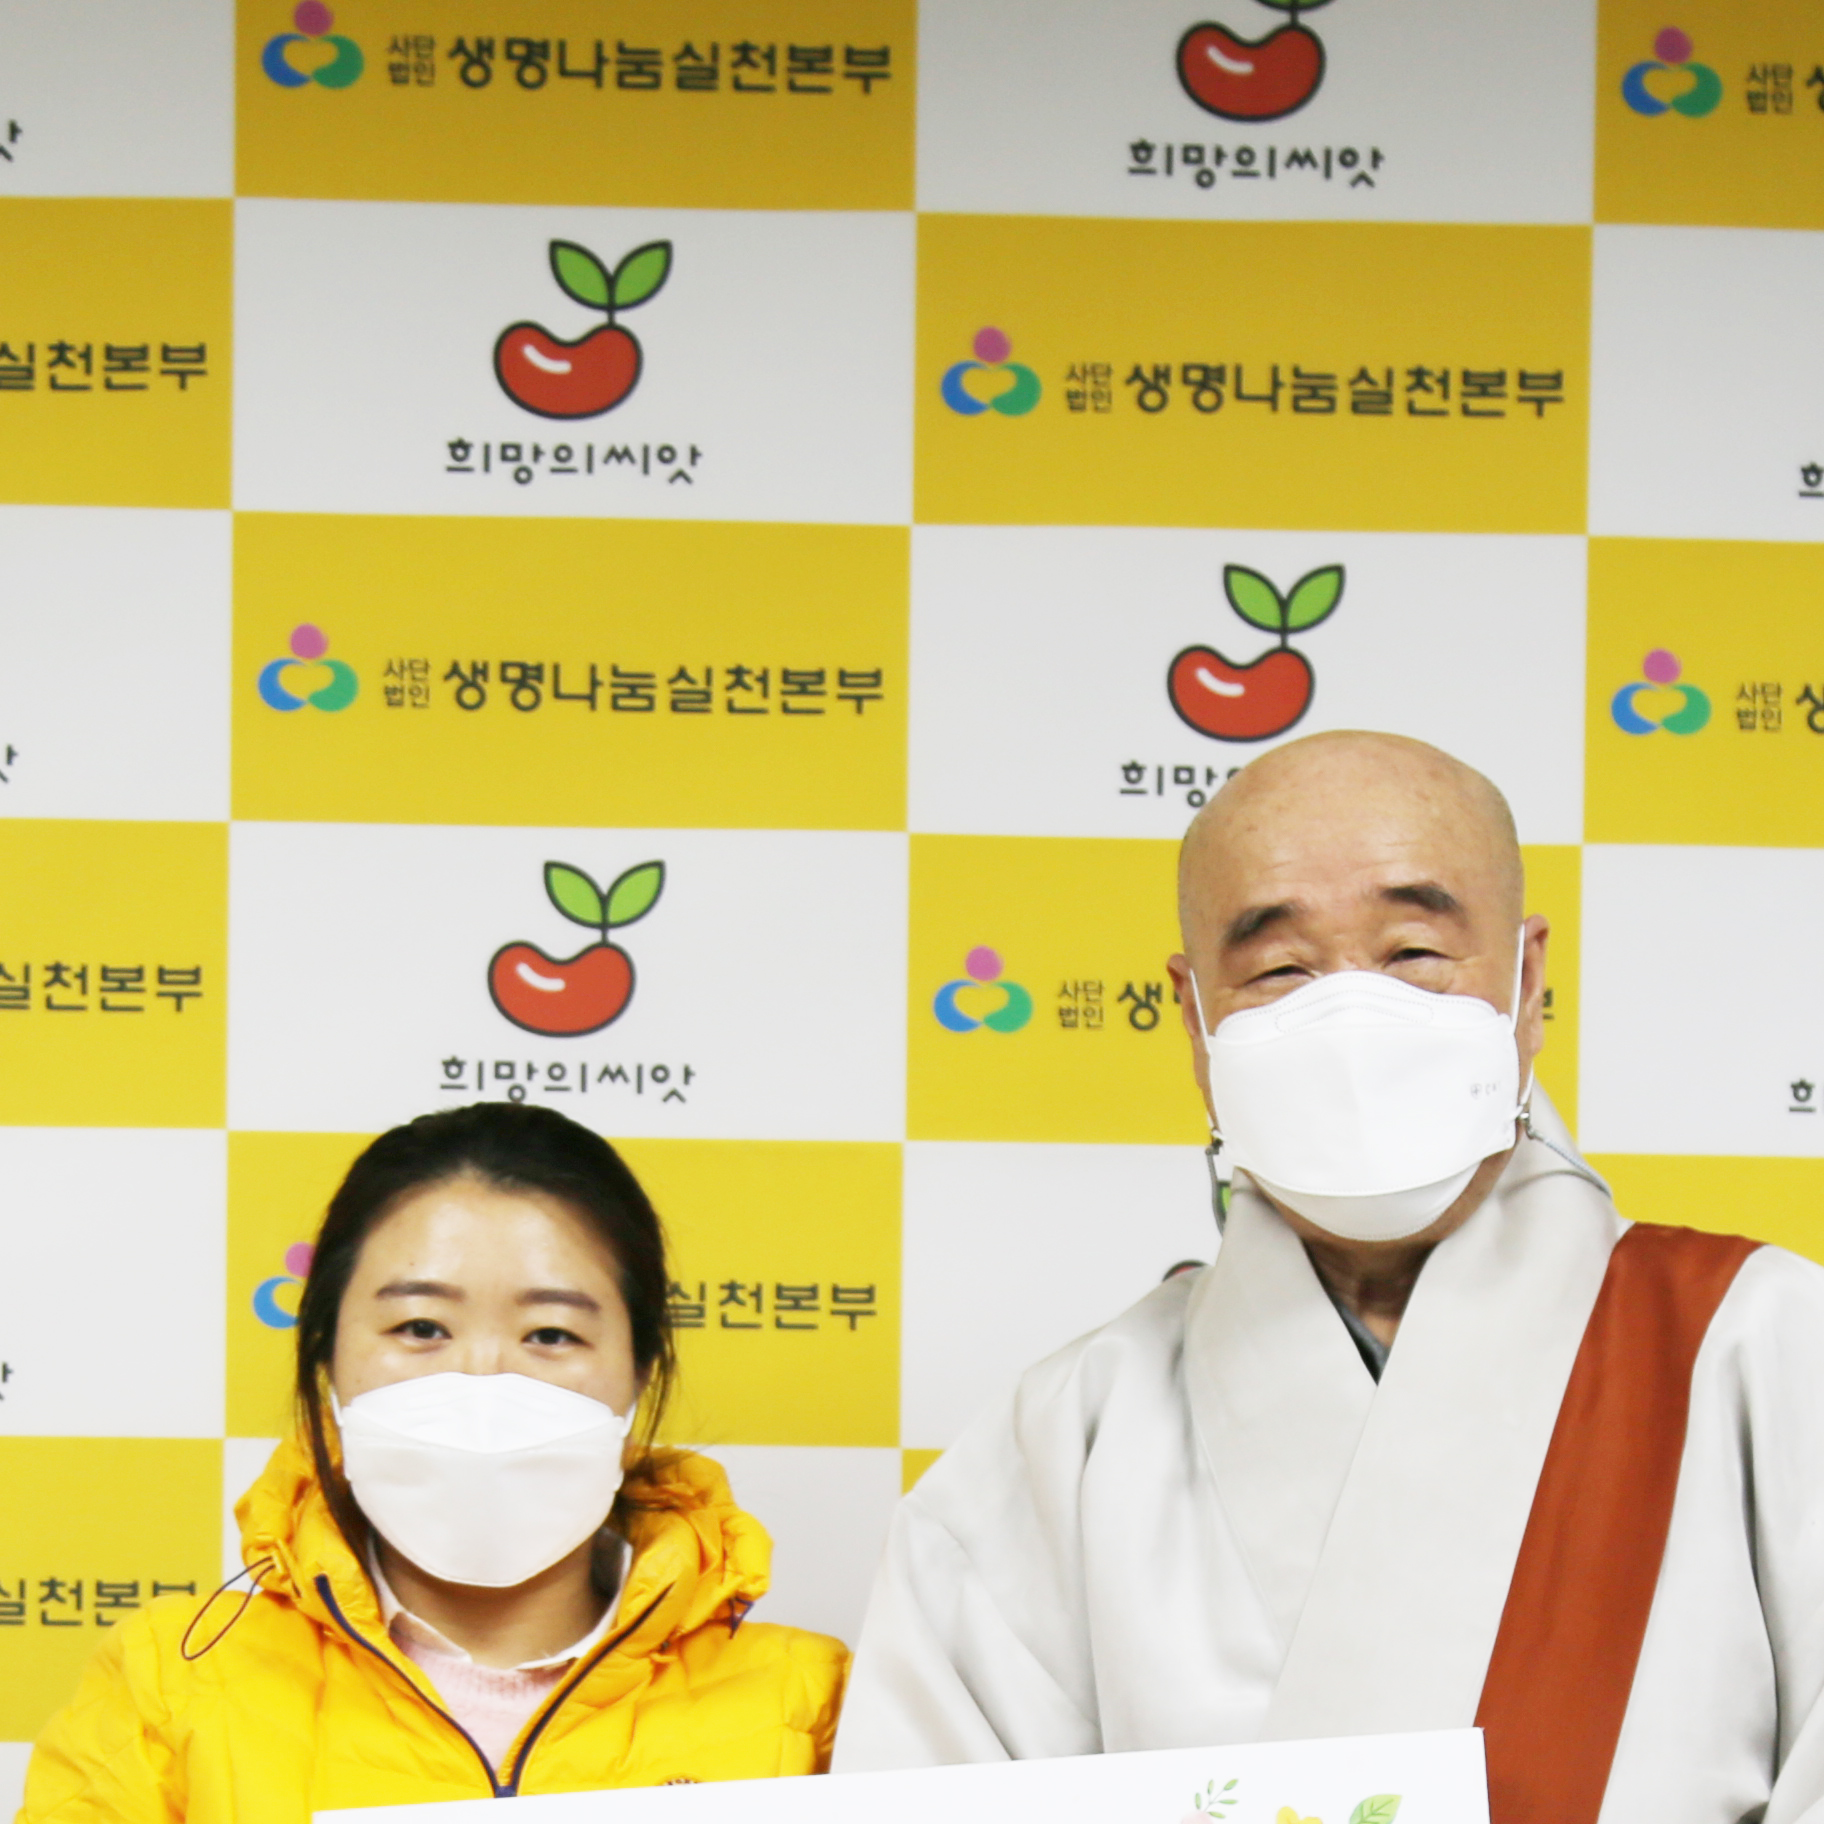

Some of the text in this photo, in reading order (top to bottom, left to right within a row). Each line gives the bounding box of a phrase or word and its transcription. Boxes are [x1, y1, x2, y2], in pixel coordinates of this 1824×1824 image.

[447, 36, 892, 95] 생명나눔실천본부
[1127, 139, 1385, 190] 희망의씨앗
[1124, 362, 1564, 418] 생명나눔실천본부
[446, 437, 702, 485] 희망의씨앗
[443, 660, 884, 715] 생명나눔실천본부
[440, 1056, 695, 1104] 희망의씨앗
